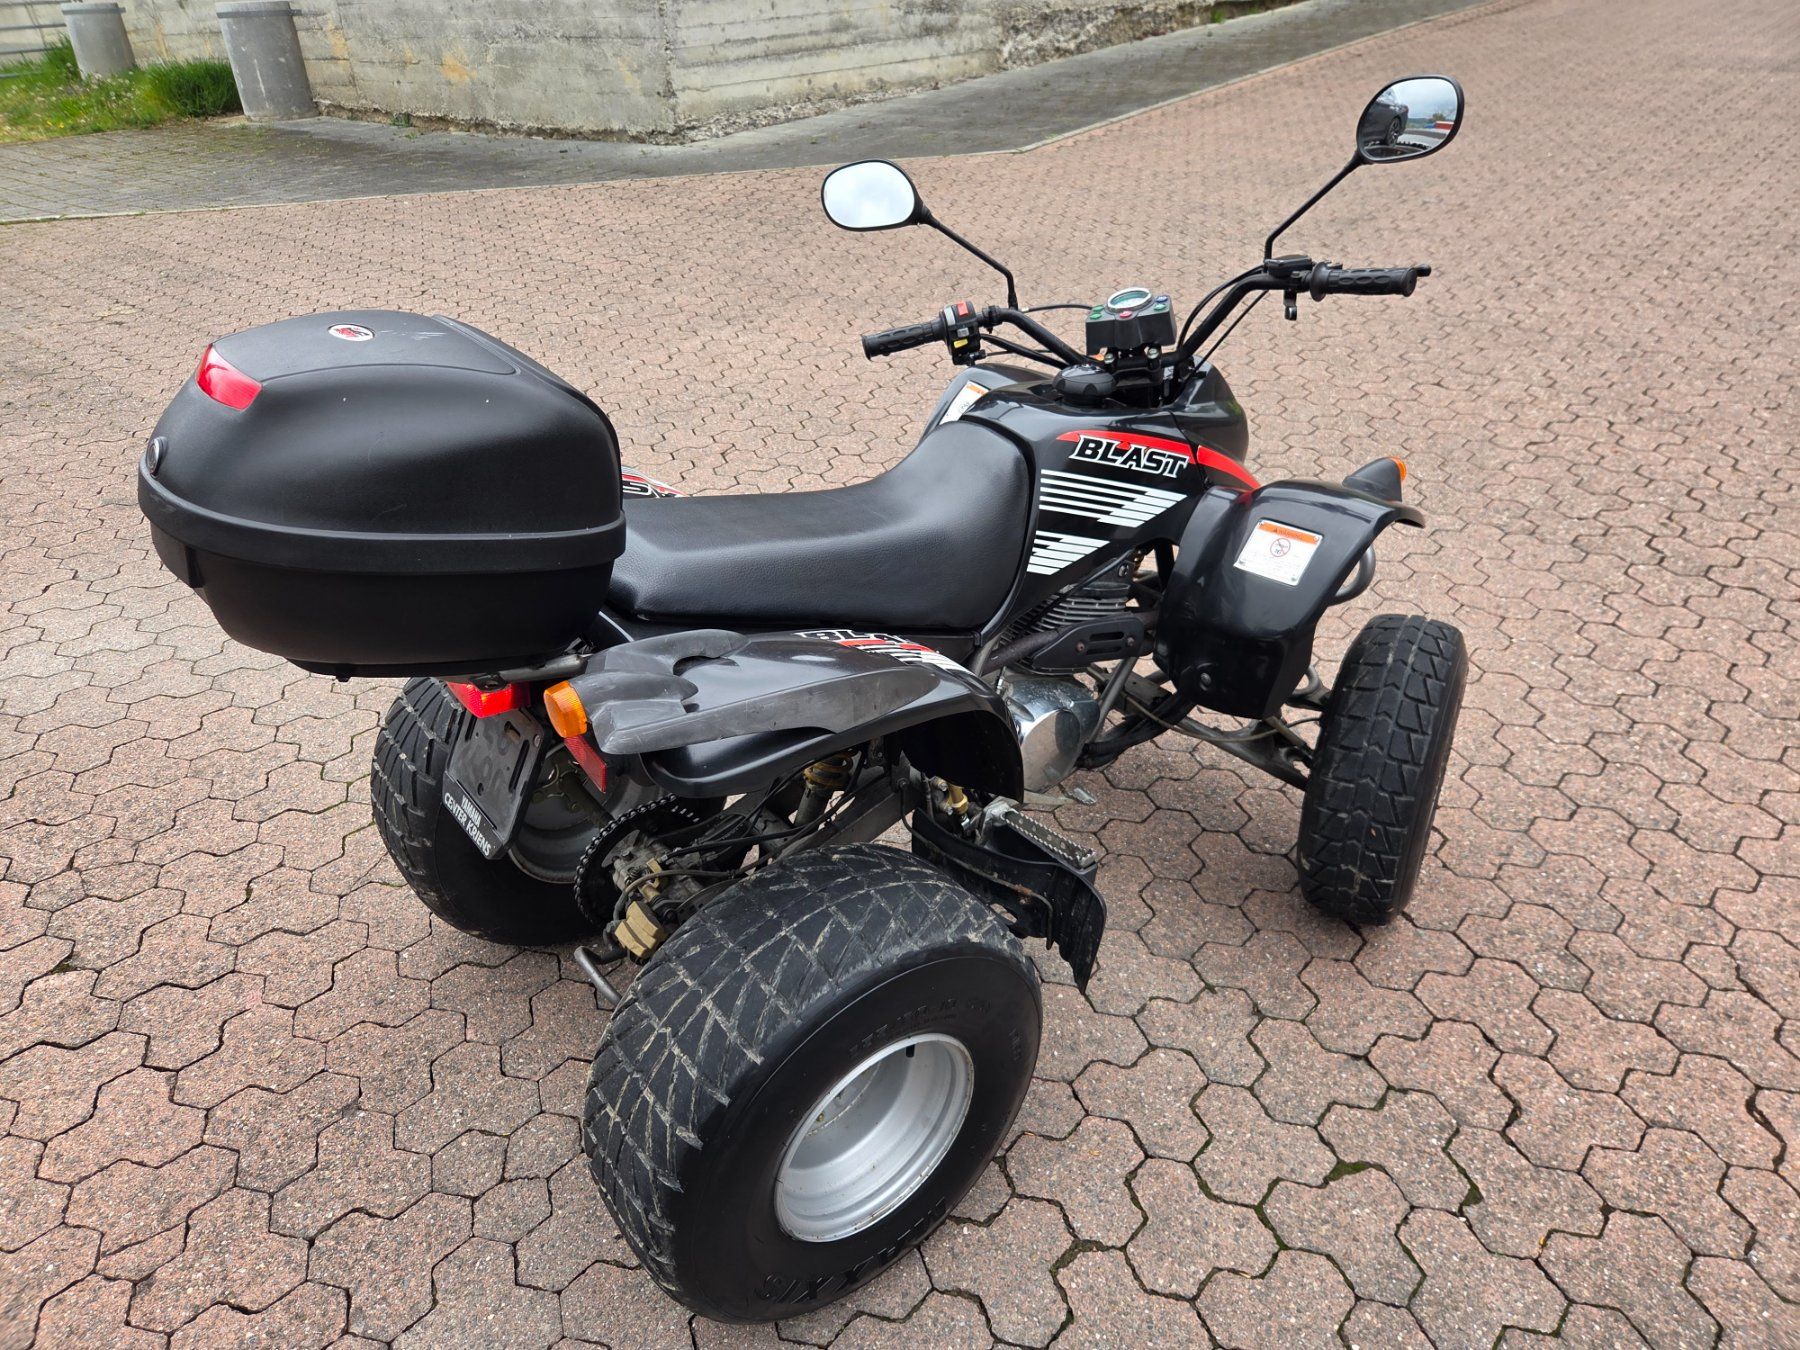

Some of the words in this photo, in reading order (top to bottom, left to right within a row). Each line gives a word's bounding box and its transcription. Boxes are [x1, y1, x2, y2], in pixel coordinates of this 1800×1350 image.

[1068, 434, 1190, 479] BLAST
[793, 629, 912, 647] BLA
[444, 792, 468, 827] CENTER
[466, 819, 492, 857] KRIENS
[461, 794, 482, 828] YAMAHA
